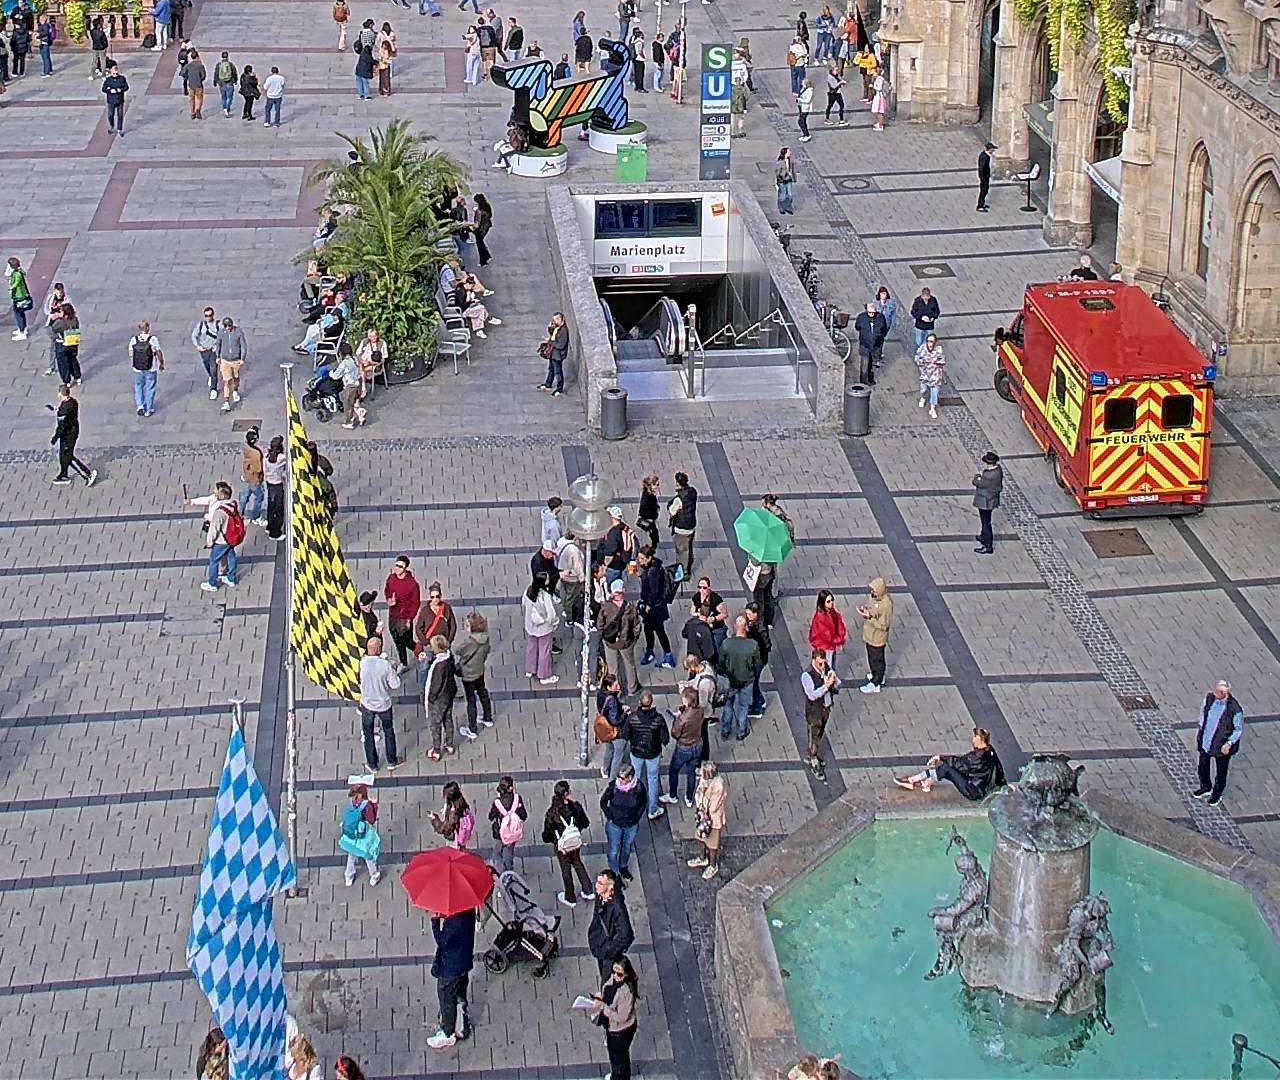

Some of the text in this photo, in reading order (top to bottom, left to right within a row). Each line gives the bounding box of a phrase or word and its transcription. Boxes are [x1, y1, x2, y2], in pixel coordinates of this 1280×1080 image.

[708, 47, 727, 69] S
[708, 75, 725, 97] U
[610, 244, 686, 258] Marienplatz
[1105, 432, 1186, 445] FEUERWEHR
